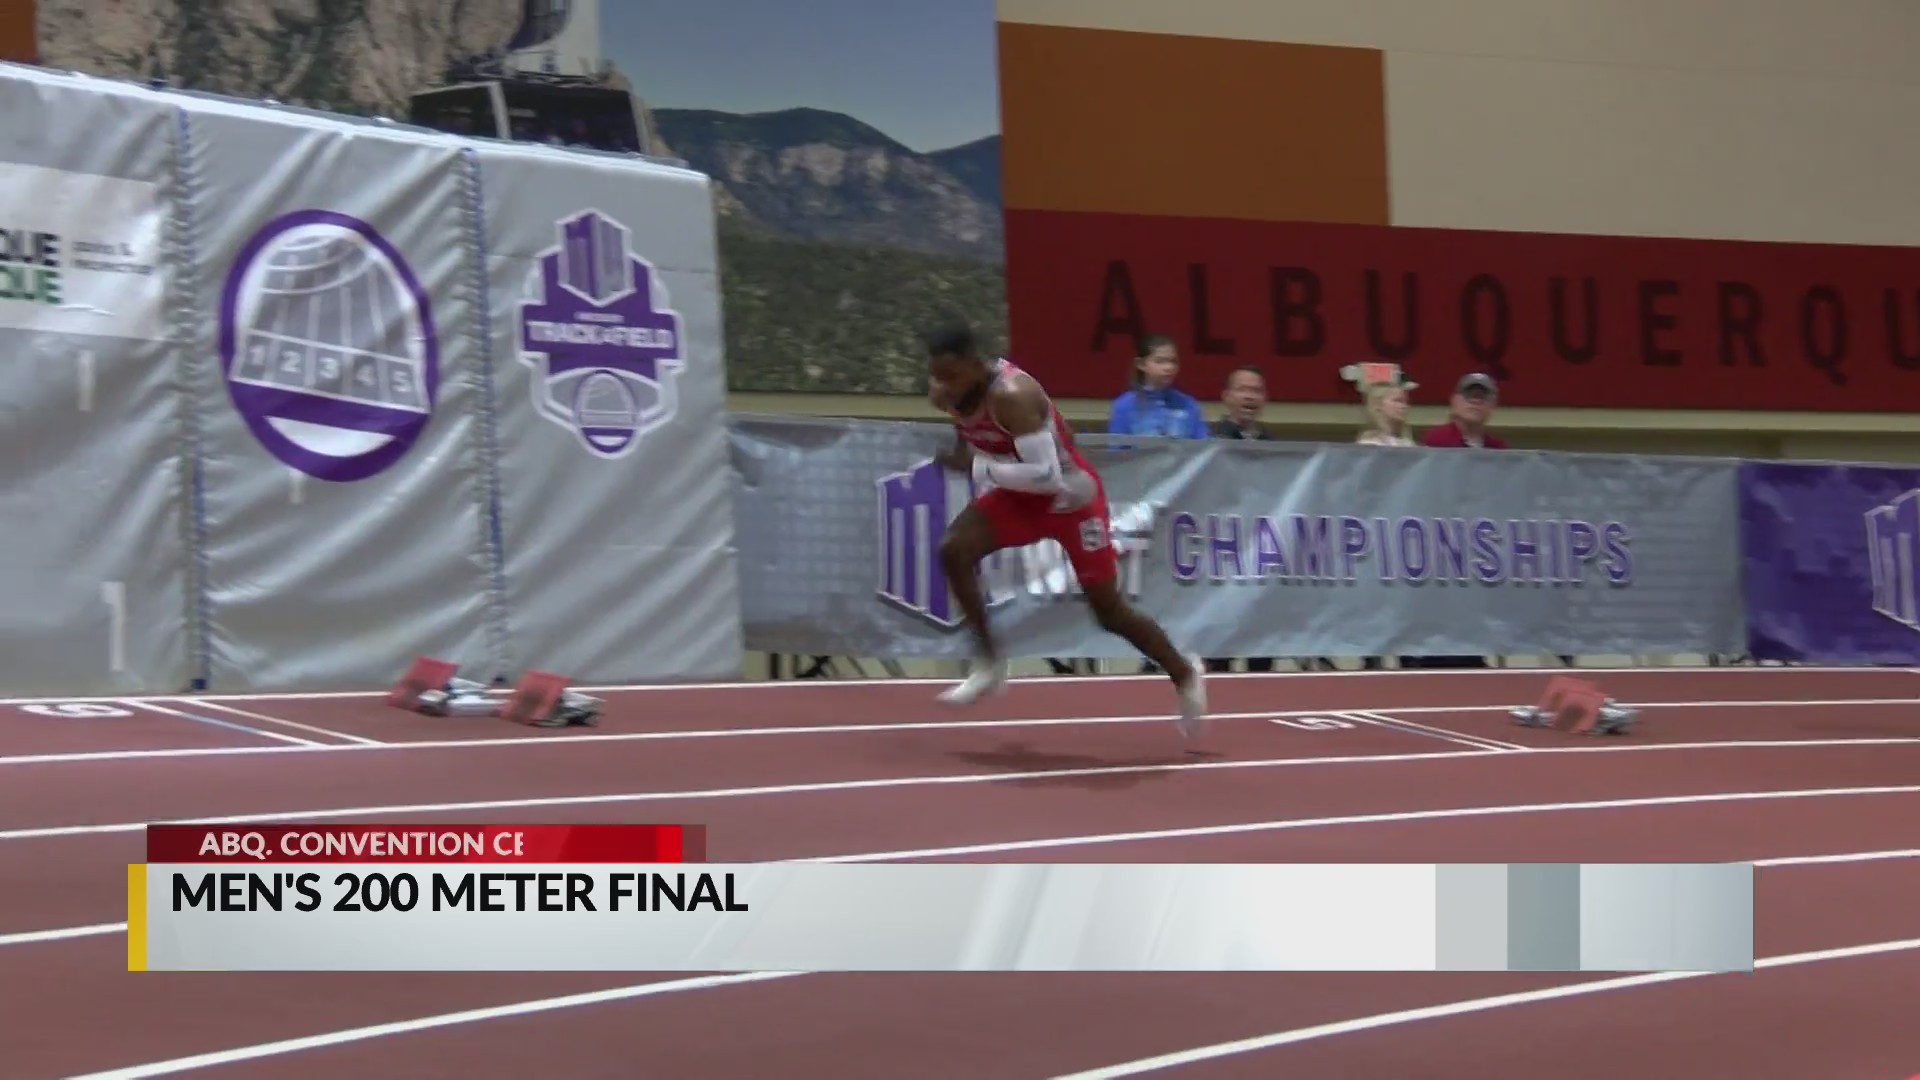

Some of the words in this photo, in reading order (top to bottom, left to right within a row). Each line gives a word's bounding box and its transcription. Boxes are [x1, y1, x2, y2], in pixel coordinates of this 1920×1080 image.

[249, 345, 265, 366] 1
[280, 351, 299, 373] 2
[319, 357, 339, 380] 3
[356, 365, 375, 386] 4
[392, 370, 412, 393] 5
[1169, 511, 1635, 587] CHAMPIONSHIPS
